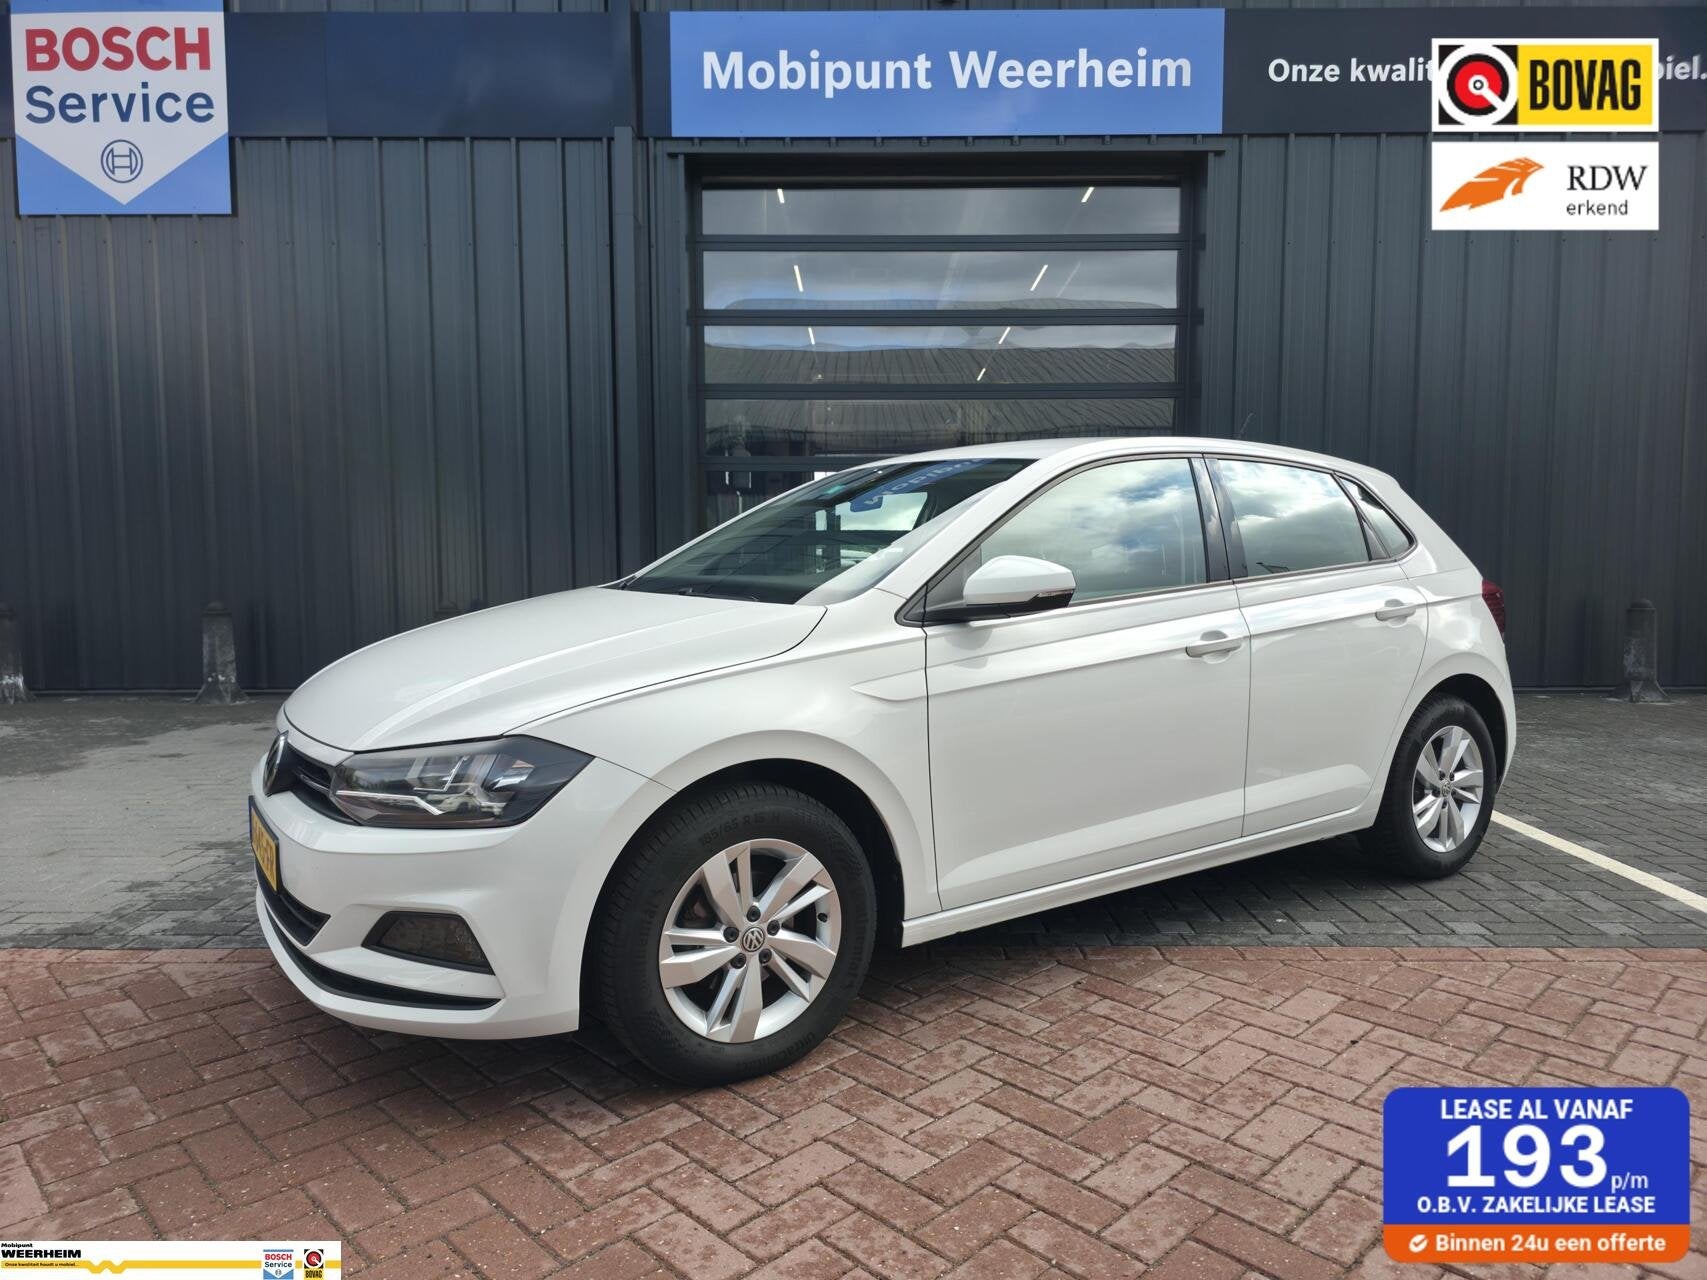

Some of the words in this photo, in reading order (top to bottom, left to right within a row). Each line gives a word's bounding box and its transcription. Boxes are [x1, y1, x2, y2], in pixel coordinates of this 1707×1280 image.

[25, 26, 211, 72] BOSCH
[1268, 58, 1340, 82] Onze
[703, 49, 932, 98] Mobipunt
[948, 47, 1191, 89] Weerheim
[25, 81, 214, 124] Service
